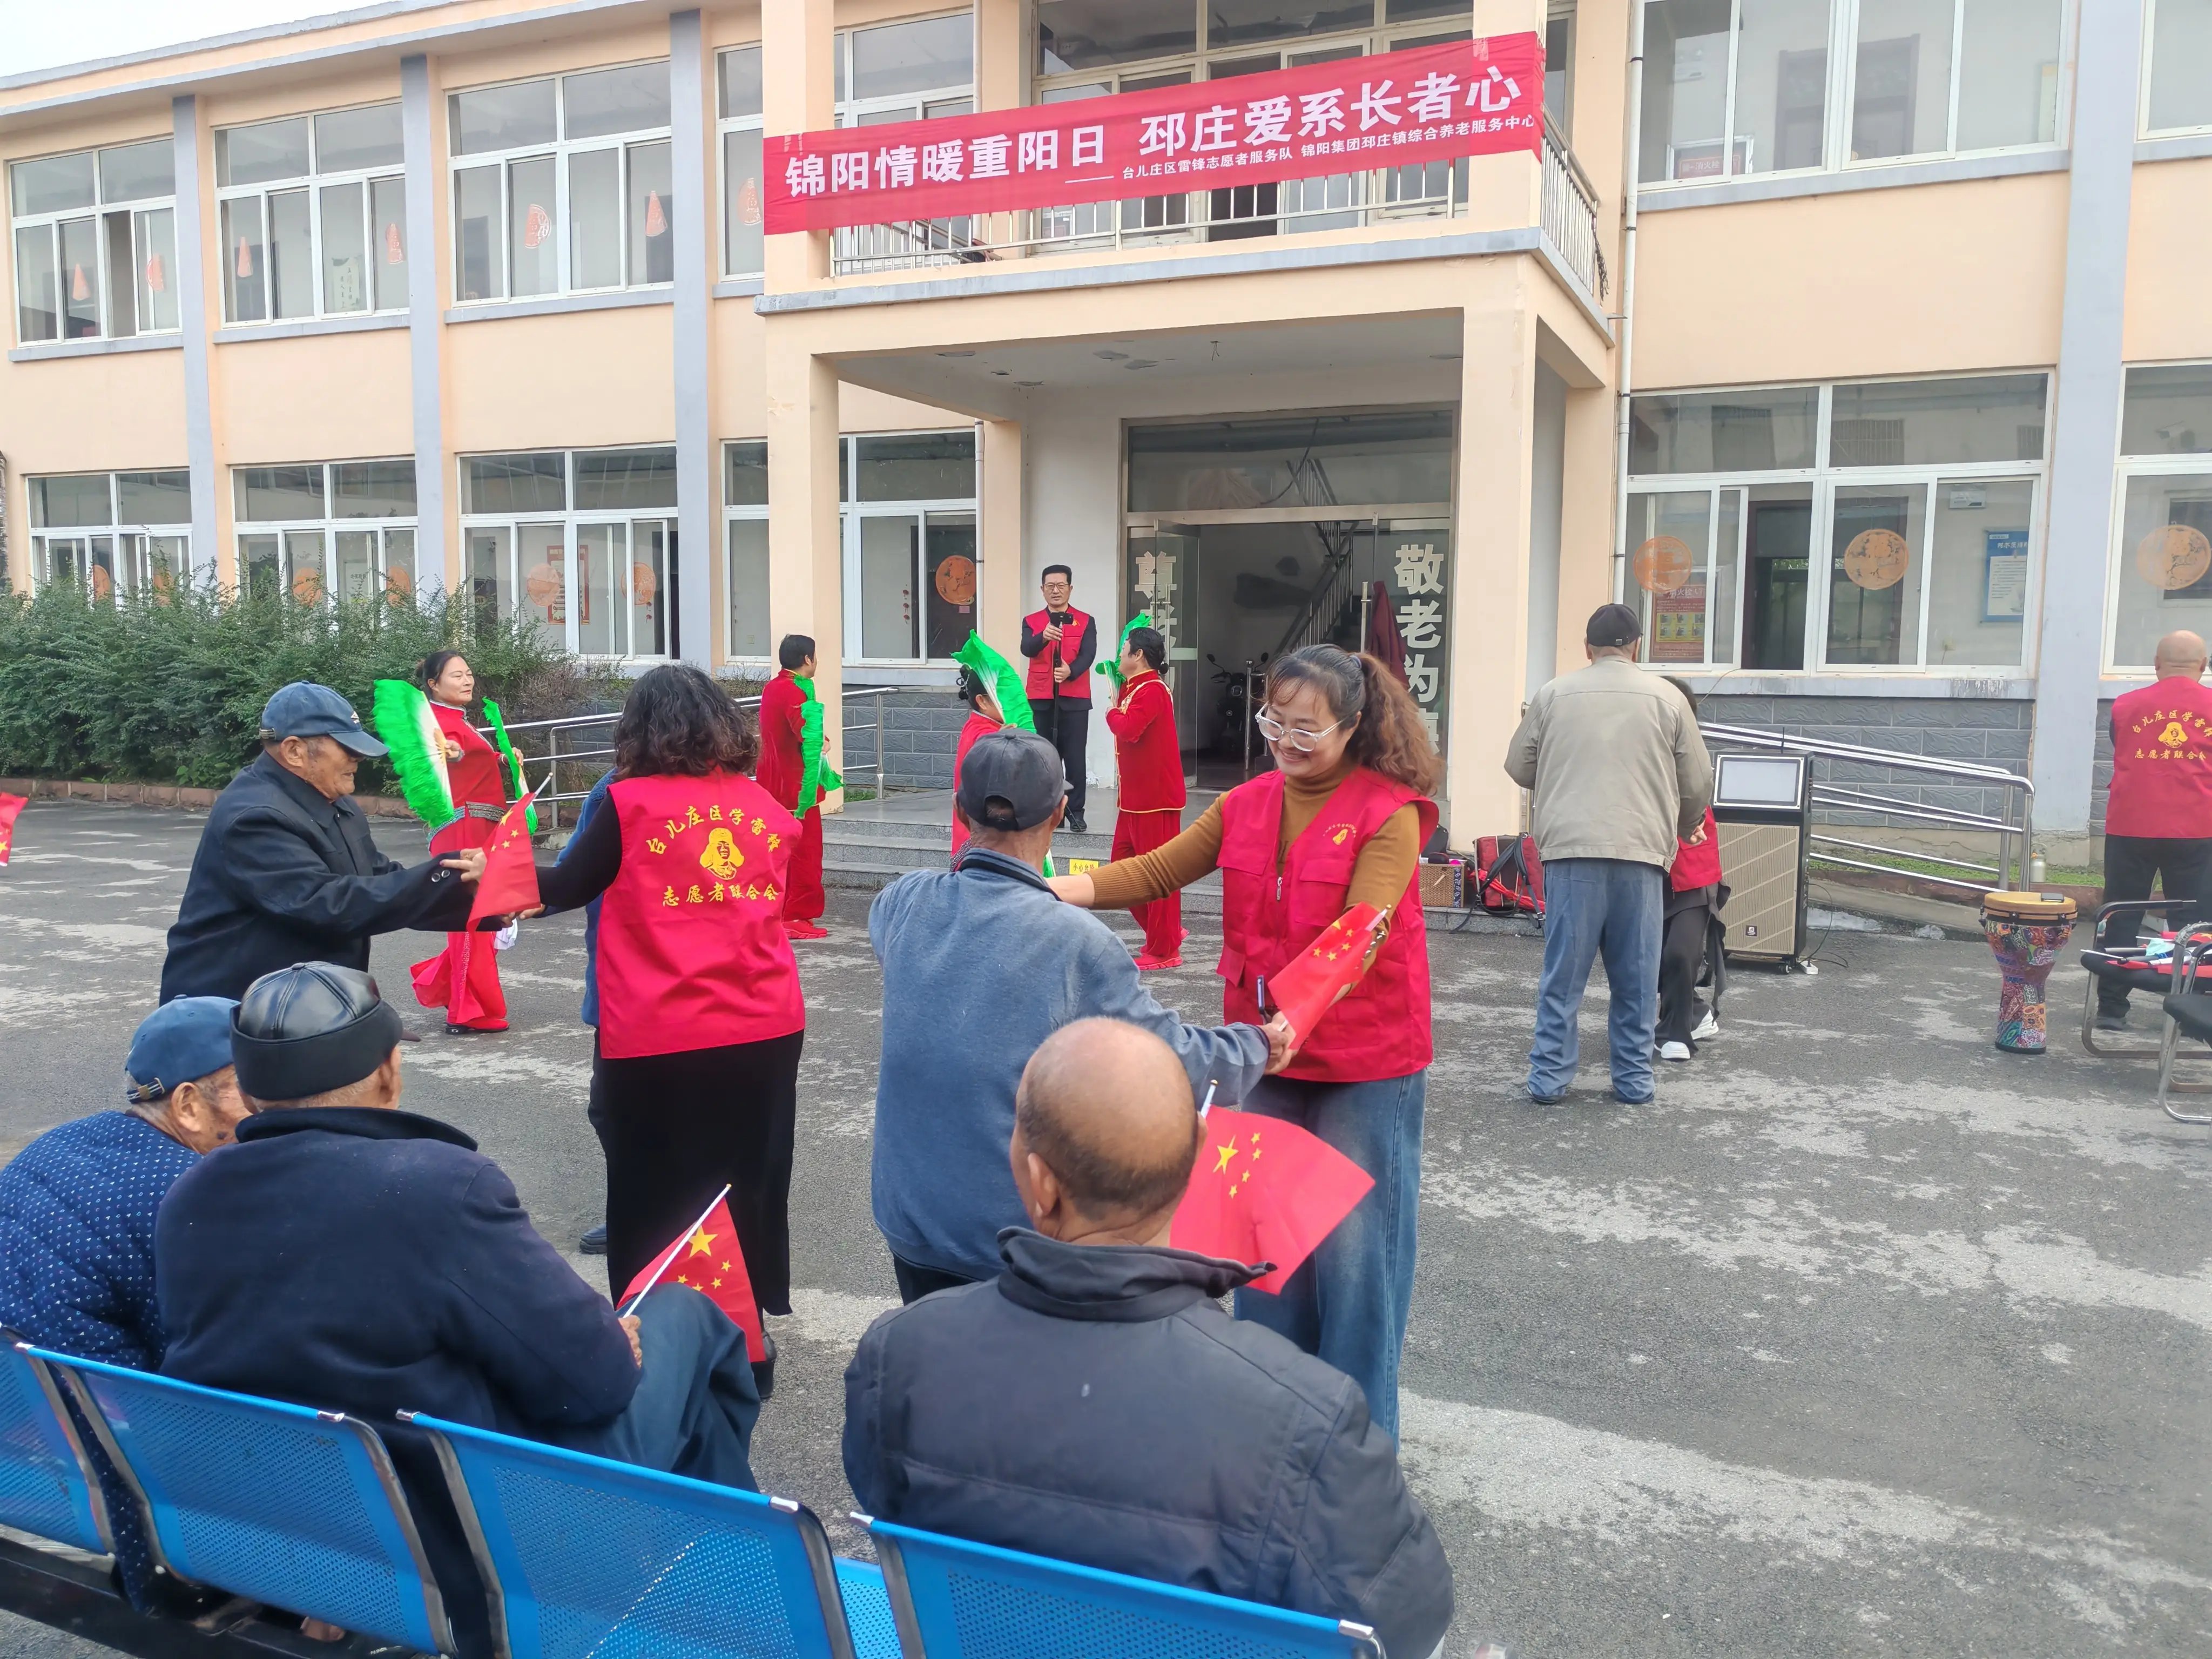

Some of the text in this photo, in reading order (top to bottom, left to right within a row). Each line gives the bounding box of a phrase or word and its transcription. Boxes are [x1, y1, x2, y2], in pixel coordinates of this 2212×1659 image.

[785, 65, 1522, 198] 锦阳情暖重阳日 邳庄爱系长者心
[1123, 114, 1534, 179] 台儿庄区雷锋志愿者服务队 锦阳集团邳庄镇综合养老服务中心
[663, 881, 779, 907] 志愿者联合会
